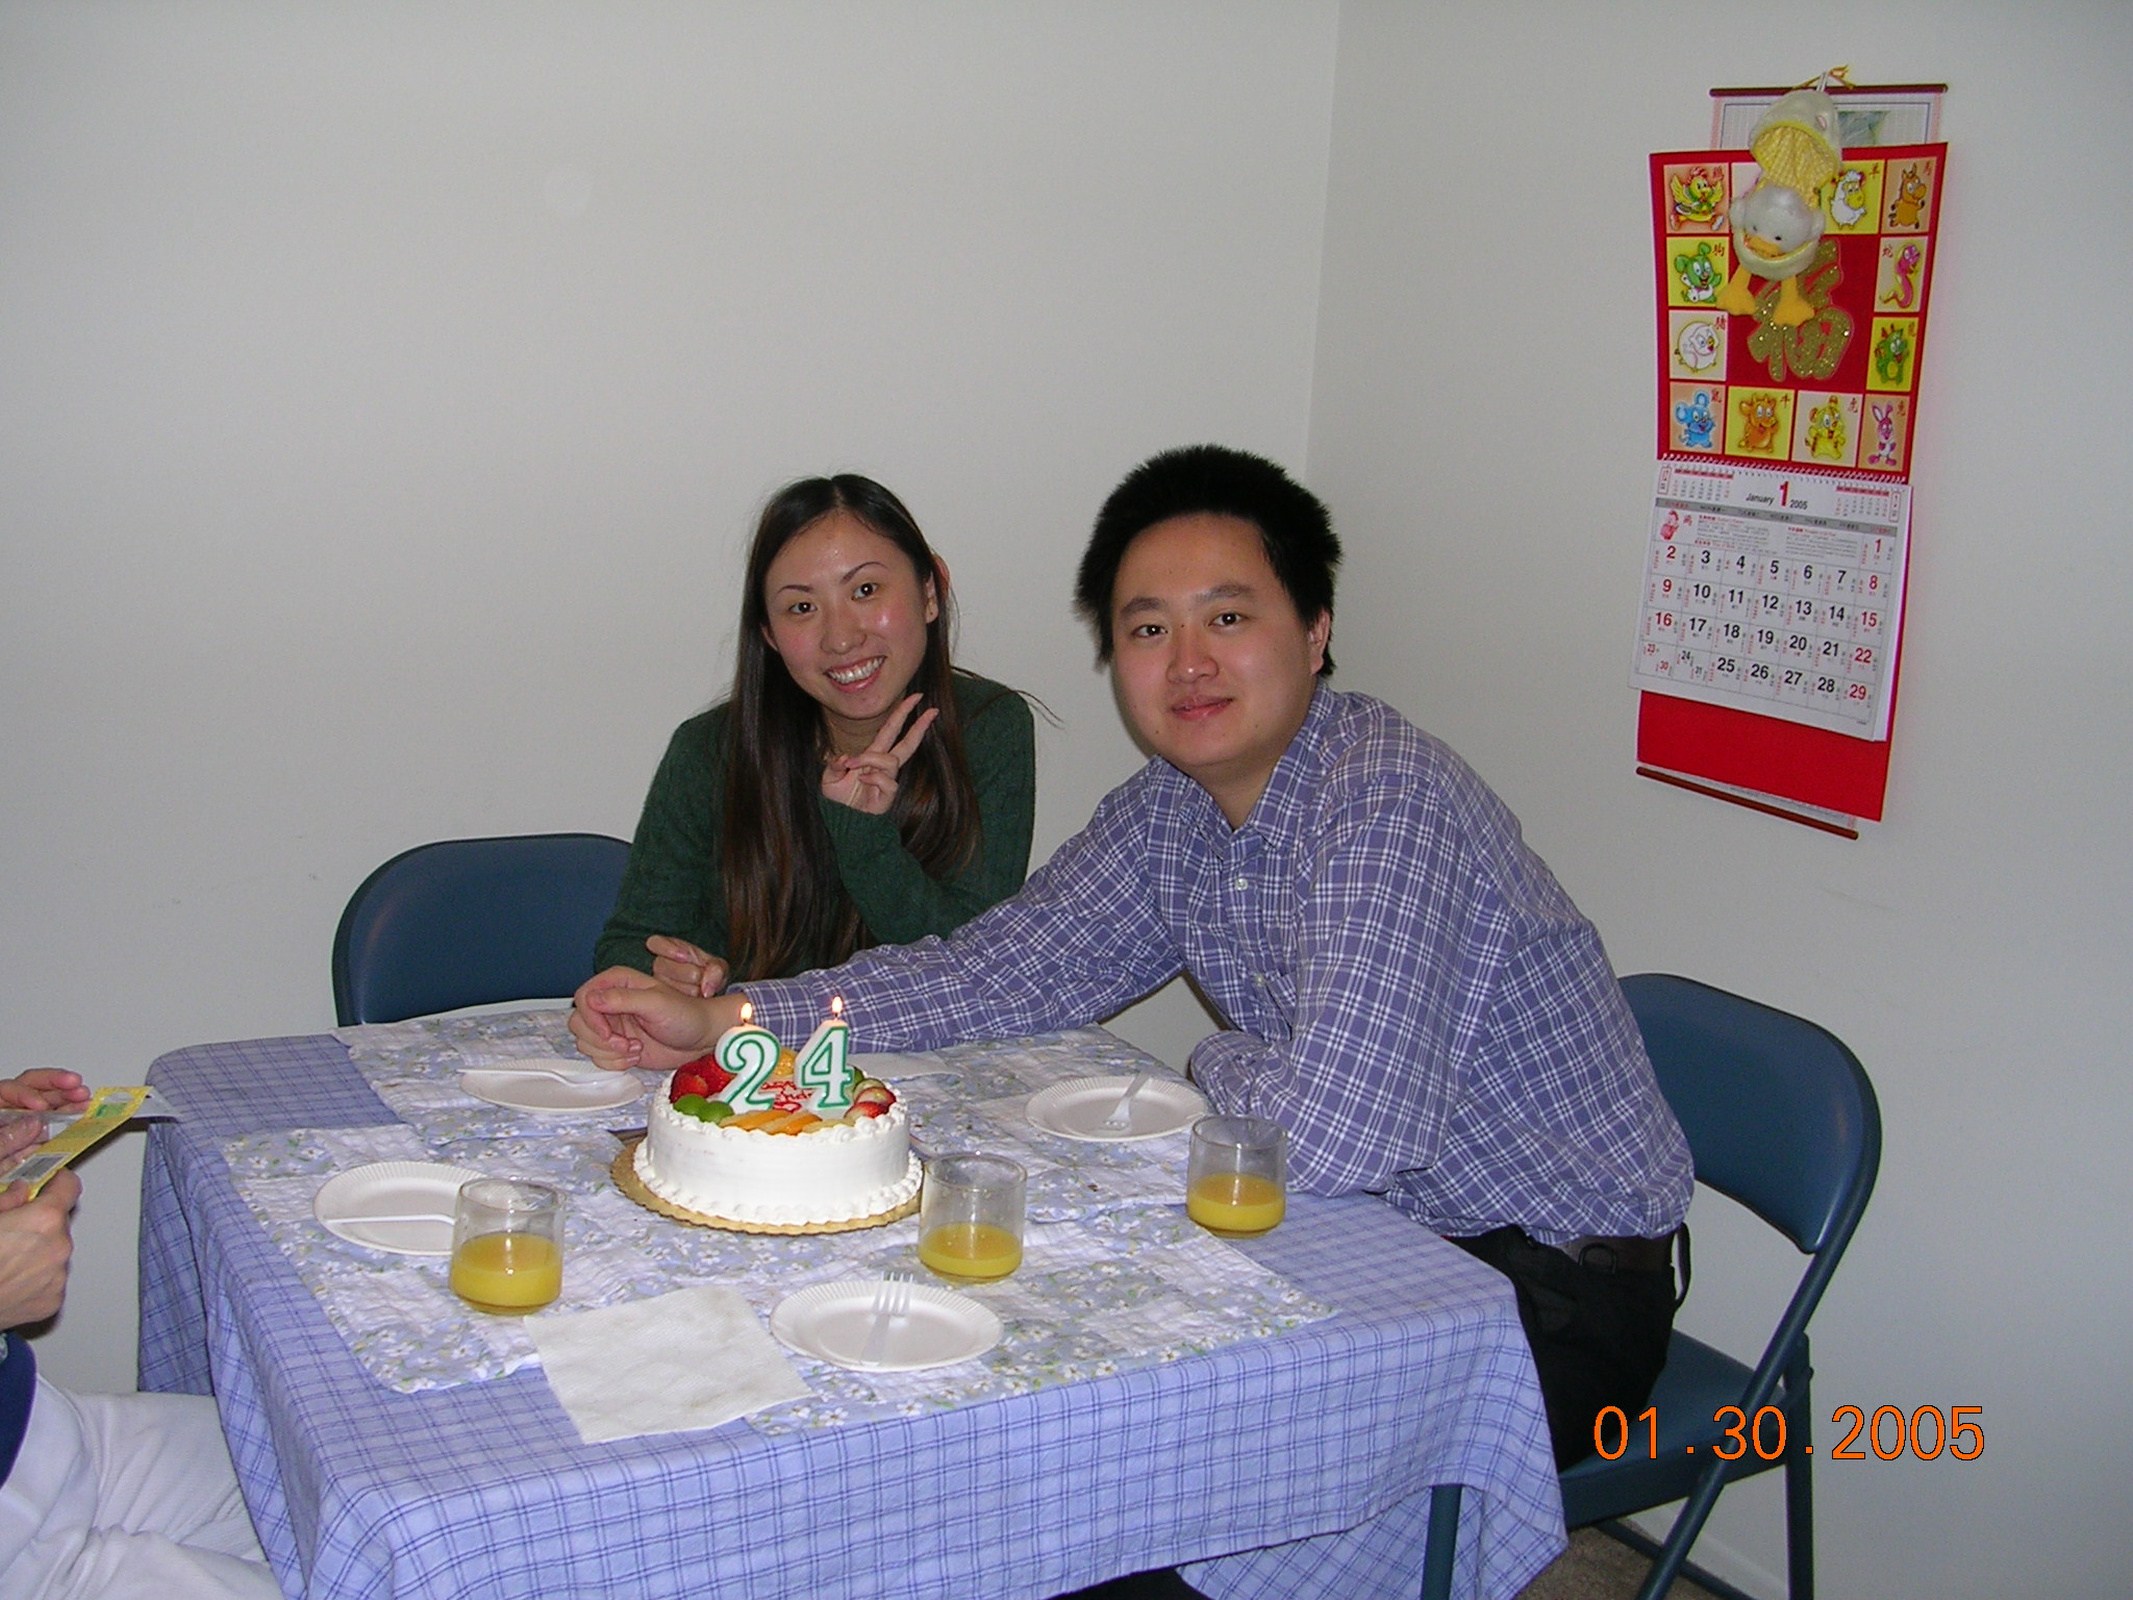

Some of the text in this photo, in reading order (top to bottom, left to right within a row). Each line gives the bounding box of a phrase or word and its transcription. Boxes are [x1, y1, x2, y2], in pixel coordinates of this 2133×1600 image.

[1745, 481, 1808, 510] January 1 2005
[1666, 545, 1878, 590] 2 3 4 5 6 7 8
[1874, 538, 1883, 553] 1
[1663, 579, 1878, 628] 9 10 11 12 13 14 15
[1656, 612, 1873, 663] 16 17 18 19 20 21 22
[1717, 657, 1736, 673] 25
[1751, 664, 1769, 679] 26
[1784, 670, 1803, 685] 27
[1817, 677, 1835, 693] 28
[1849, 684, 1867, 700] 29
